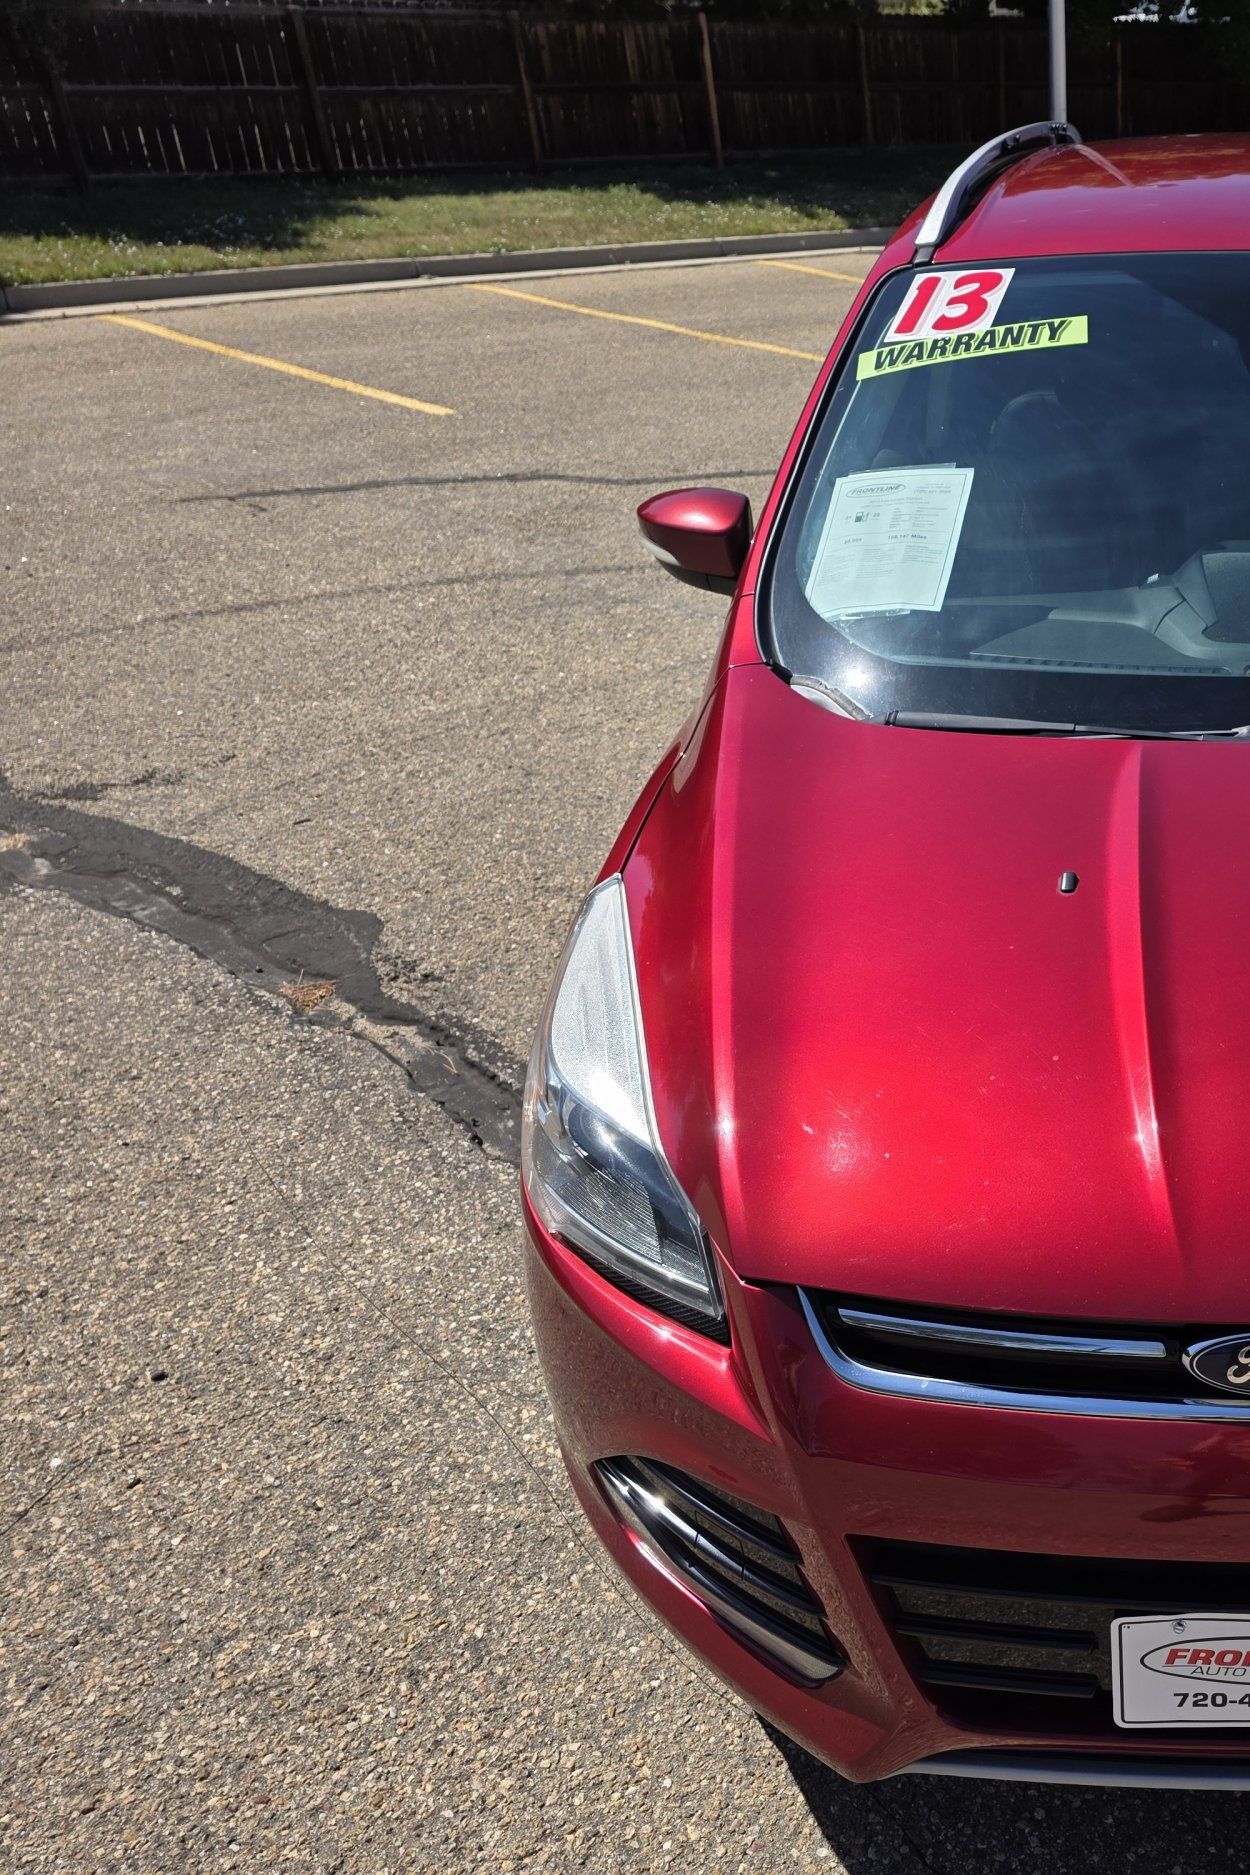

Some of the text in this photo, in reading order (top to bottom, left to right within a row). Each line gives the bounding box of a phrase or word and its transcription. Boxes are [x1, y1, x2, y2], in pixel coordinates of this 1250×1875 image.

[894, 271, 1004, 335] 13
[873, 319, 1073, 371] WARRANTY
[850, 485, 901, 496] FRONTLINE
[1190, 1665, 1248, 1677] AUTO
